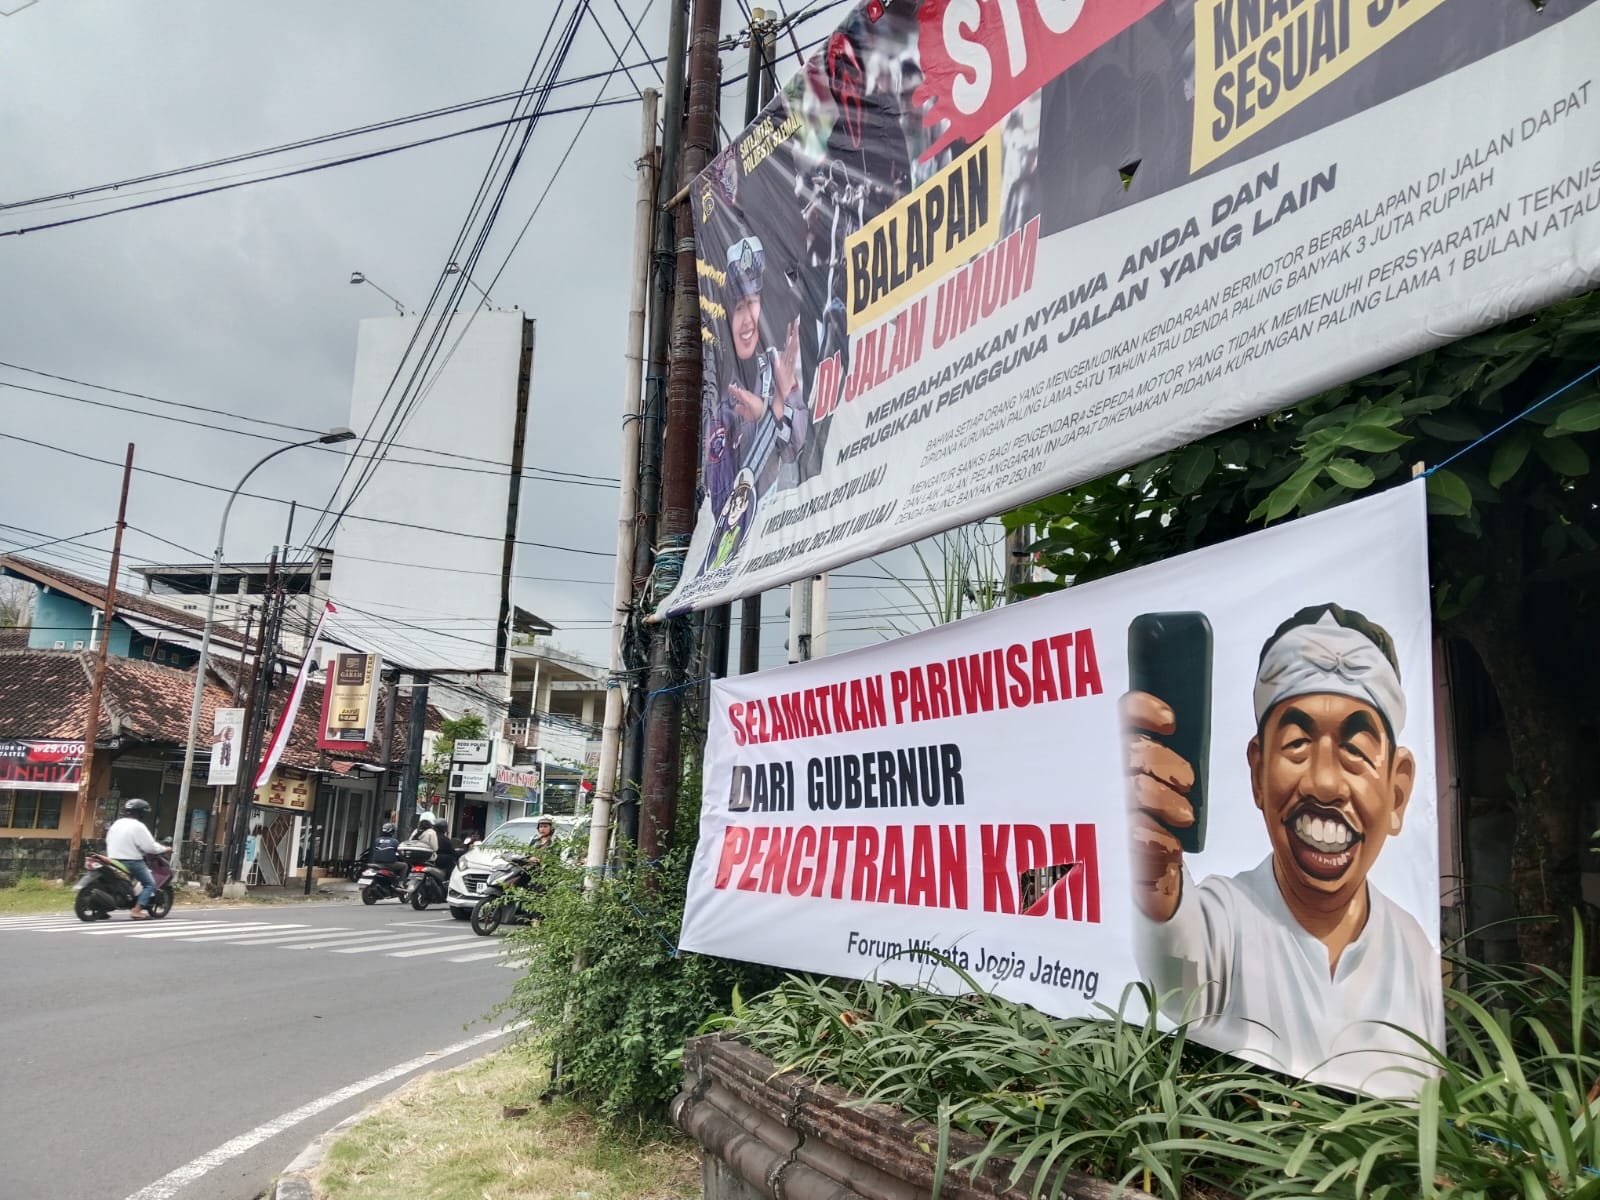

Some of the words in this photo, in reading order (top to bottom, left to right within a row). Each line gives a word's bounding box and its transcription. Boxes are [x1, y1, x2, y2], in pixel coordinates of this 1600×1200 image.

[1212, 0, 1350, 142] SESUAI
[813, 350, 841, 423] DI
[844, 296, 928, 402] JALAN
[932, 214, 1041, 349] UMUM
[836, 404, 933, 466] MERUGIKAN
[936, 334, 1048, 413] PENGGUNA
[1057, 277, 1149, 343] JALAN
[1159, 223, 1242, 289] YANG
[1252, 162, 1337, 236] LAIN
[851, 145, 989, 316] BALAPAN
[865, 324, 1019, 428] MEMBAHAYAKAN
[1022, 272, 1108, 337] NYAWA
[1117, 216, 1200, 282] ANDA
[1211, 161, 1279, 227] DAN
[925, 428, 953, 452] BAHWA
[954, 413, 984, 439] SETIAP
[984, 396, 1017, 421] ORANG
[1018, 381, 1045, 401] YANG
[1045, 336, 1139, 390] MENGEMUDIKAN
[1141, 292, 1220, 346] KENDARAAN
[1222, 245, 1304, 304] BERMOTOR
[1308, 181, 1421, 256] BERBALAPAN
[1427, 168, 1446, 194] DI
[1450, 128, 1514, 180] JALAN
[1521, 80, 1592, 141] DAPAT
[957, 420, 1005, 451] KURUNGAN
[1006, 400, 1041, 427] PALING
[1042, 385, 1072, 408] LAMA
[1073, 370, 1104, 395] SATU
[1108, 351, 1147, 380] TAHUN
[1147, 334, 1180, 362] ATAU
[1182, 308, 1228, 344] DENDA
[1231, 278, 1283, 319] PALING
[1286, 242, 1352, 289] BANYAK
[1356, 236, 1366, 254] 3
[1370, 211, 1414, 246] JUTA
[1419, 167, 1494, 222] RUPIAH
[909, 467, 956, 495] MENGATUR
[956, 453, 988, 475] SANKSI
[988, 444, 1011, 463] BAGI
[1012, 410, 1086, 449] PENGENDARA
[1086, 388, 1134, 419] SEPEDA
[1136, 364, 1184, 398] MOTOR
[1187, 344, 1224, 374] YANG
[1228, 320, 1269, 354] TIDAK
[1271, 275, 1364, 332] MEMENUHI
[1367, 202, 1510, 288] PERSYARATAN
[1518, 160, 1600, 216] TEKNIS
[970, 445, 1044, 484] PELANGGARAN
[1060, 420, 1099, 446] DAPAT
[1098, 388, 1171, 431] DIKENAKAN
[1172, 365, 1222, 399] PIDANA
[1224, 321, 1314, 374] KURUNGAN
[1317, 291, 1381, 333] PALING
[1385, 265, 1441, 302] LAMA
[1448, 258, 1456, 276] 1
[1463, 221, 1538, 271] BULAN
[1543, 187, 1600, 237] ATAU
[956, 481, 995, 505] BANYAK
[728, 674, 888, 746] SELAMATKAN
[891, 628, 1103, 725] PARIWISATA
[728, 761, 794, 812] DARI
[807, 743, 965, 812] GUBERNUR
[714, 824, 969, 910] PENCITRAAN
[980, 823, 1101, 923] KDM
[848, 931, 901, 960] Forum
[908, 938, 969, 970] Wisata
[975, 947, 1026, 981] Jogja
[1030, 956, 1099, 1000] Jateng
